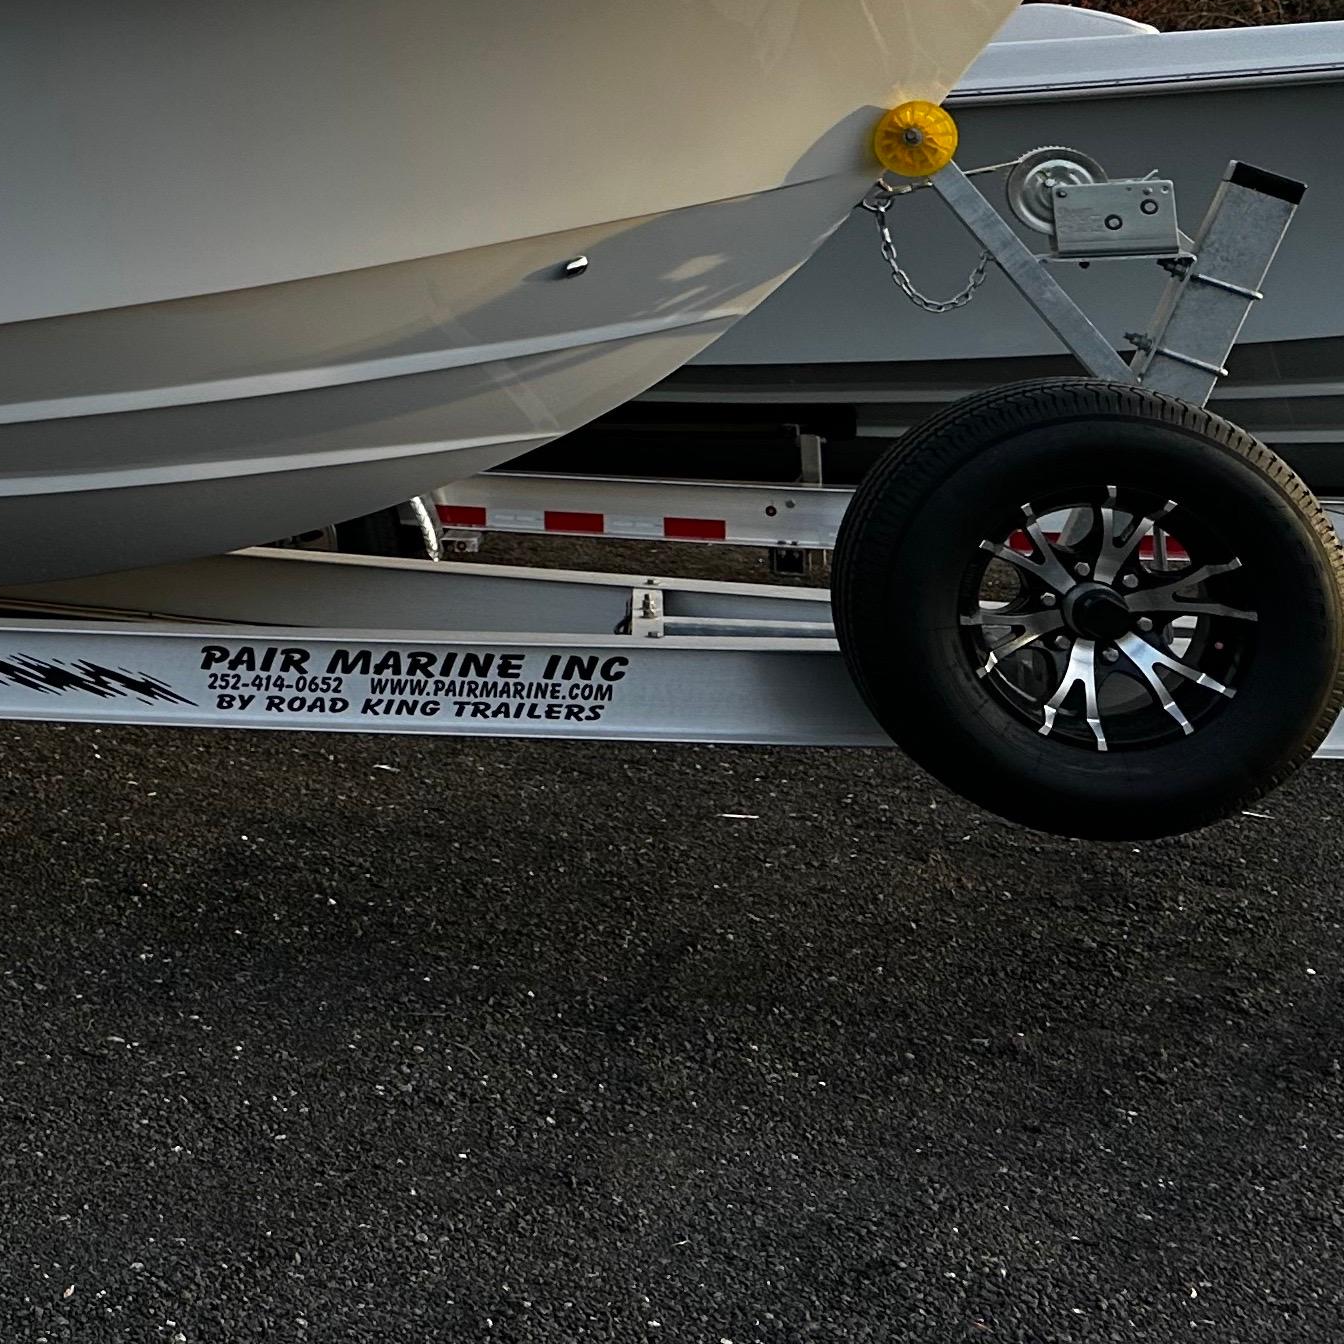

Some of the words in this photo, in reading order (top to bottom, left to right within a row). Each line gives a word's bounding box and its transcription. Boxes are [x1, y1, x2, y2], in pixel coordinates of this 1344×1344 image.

[200, 645, 311, 675] PAIR
[325, 649, 526, 679] MARINE
[542, 654, 630, 682] INC
[207, 673, 344, 694] 252-414-0652
[370, 677, 613, 702] WWW.PAIRMARINE.COM
[216, 693, 256, 711] BY
[265, 695, 350, 713] ROAD
[360, 698, 441, 716] KING
[453, 700, 605, 722] TRAILERS
